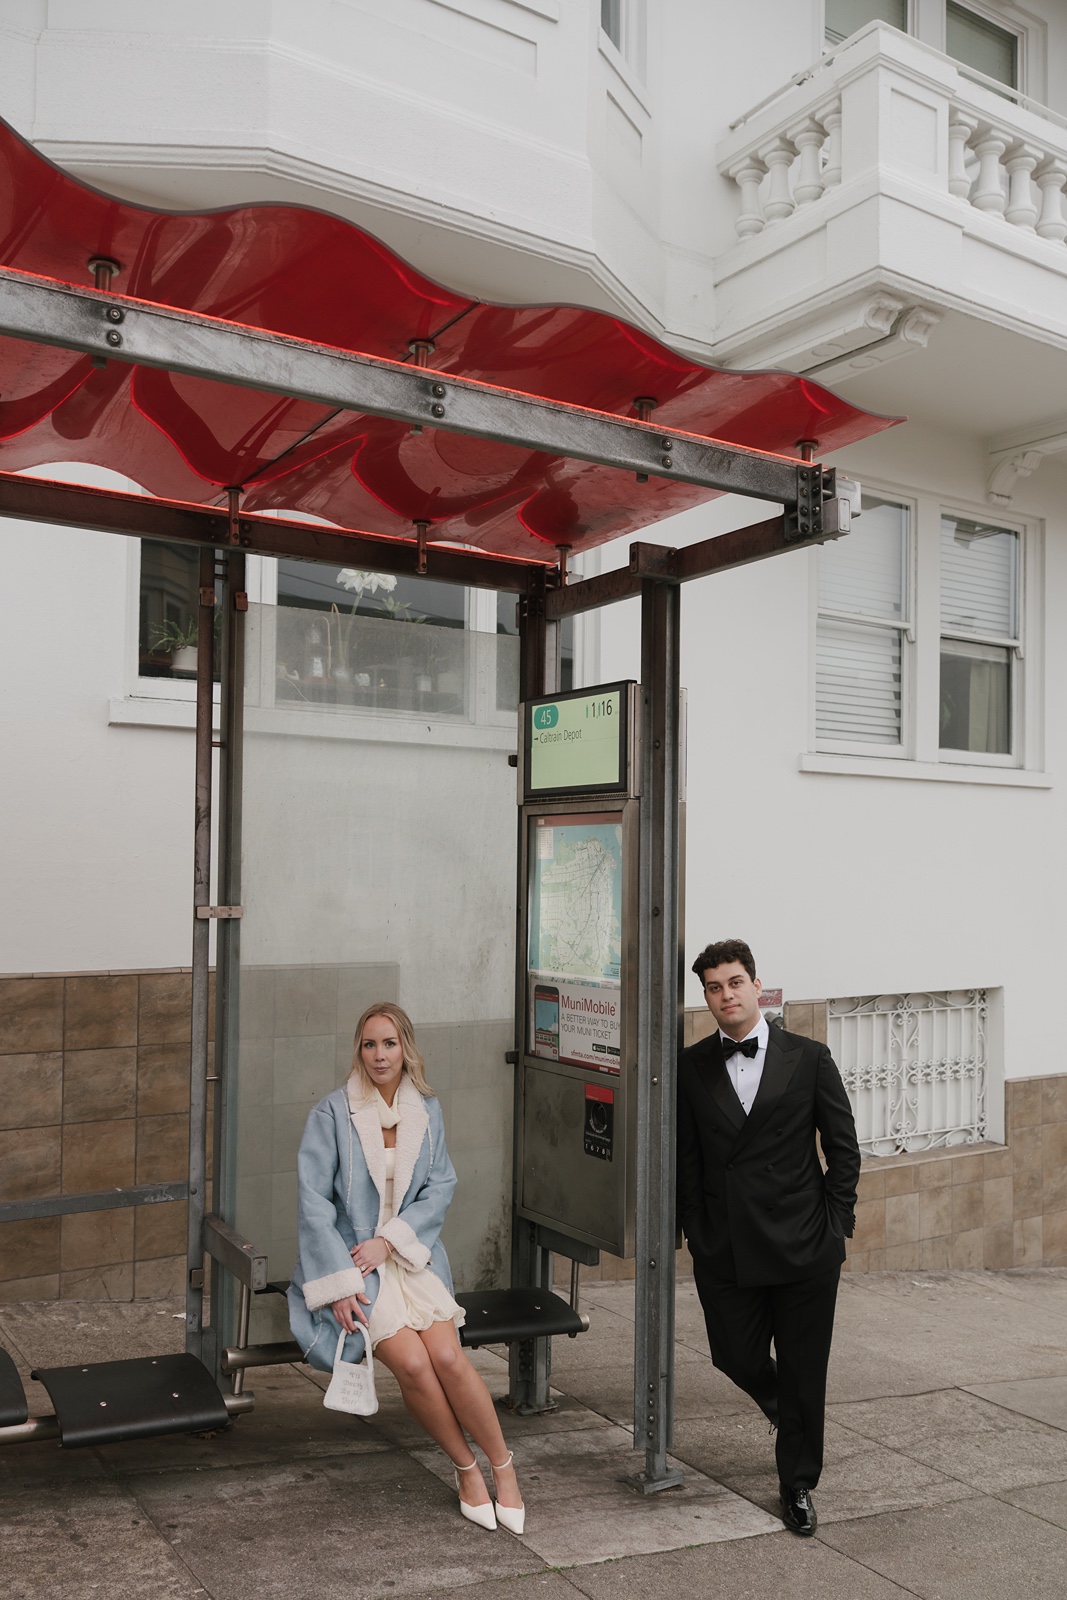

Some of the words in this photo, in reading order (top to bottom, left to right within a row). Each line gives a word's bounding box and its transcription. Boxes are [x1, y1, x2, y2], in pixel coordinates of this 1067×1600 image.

[540, 709, 552, 725] 45
[602, 699, 612, 716] 16
[564, 729, 582, 742] Depot
[561, 1013, 565, 1021] A
[566, 1013, 586, 1025] BETTER
[587, 1017, 600, 1027] WAY
[601, 1019, 609, 1029] TO
[561, 1023, 575, 1034] YOUR
[576, 1026, 592, 1036] MUNI
[592, 1028, 611, 1040] TICKET
